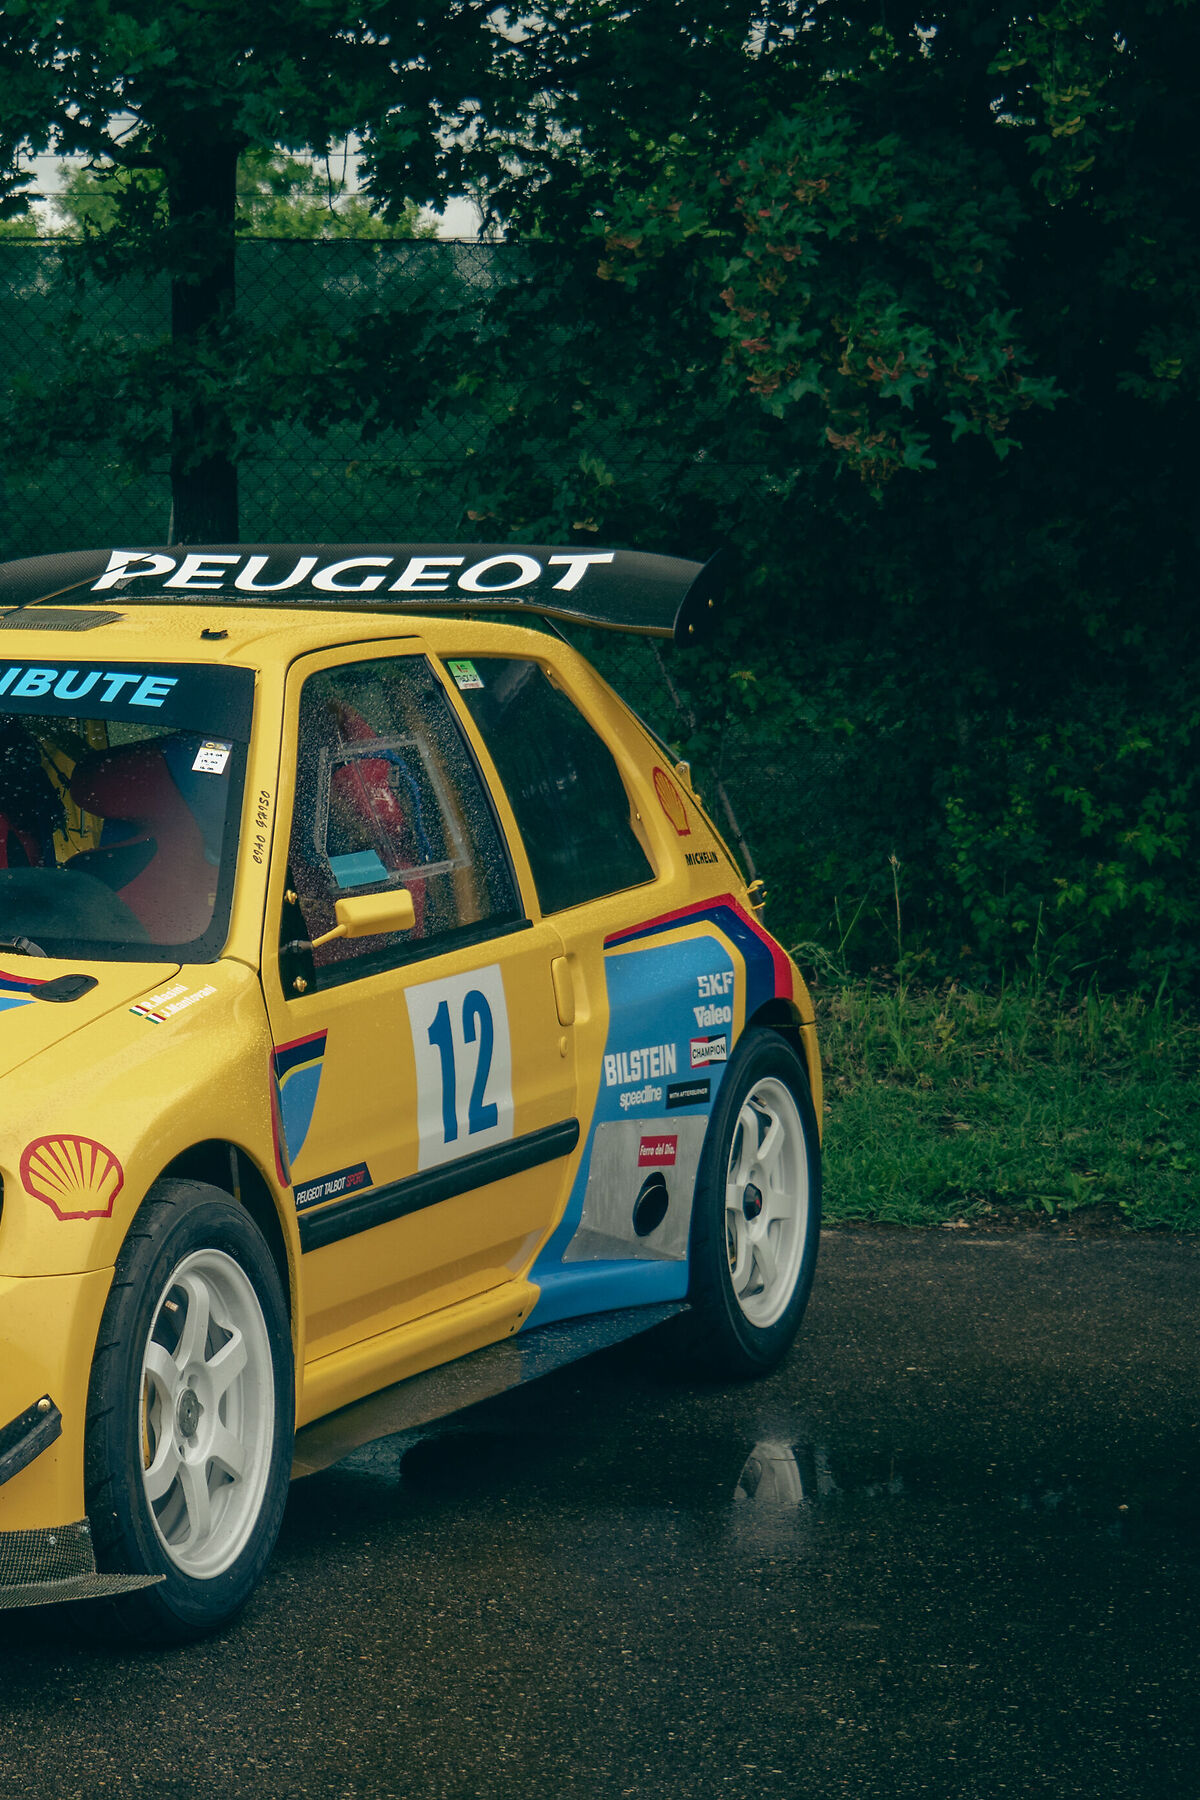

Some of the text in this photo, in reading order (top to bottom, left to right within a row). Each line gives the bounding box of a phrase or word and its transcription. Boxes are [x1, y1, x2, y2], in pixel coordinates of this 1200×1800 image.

[90, 550, 615, 592] PEUGEOT
[685, 851, 719, 866] MICHELIN
[697, 971, 734, 998] SKF
[693, 1003, 732, 1028] Valeo
[604, 1043, 677, 1087] BILSTEIN
[692, 1043, 726, 1060] CHAMPION
[427, 989, 498, 1144] 12
[620, 1085, 662, 1111] speedline
[296, 1170, 366, 1205] PEUGEOT TALBOT SPORT
